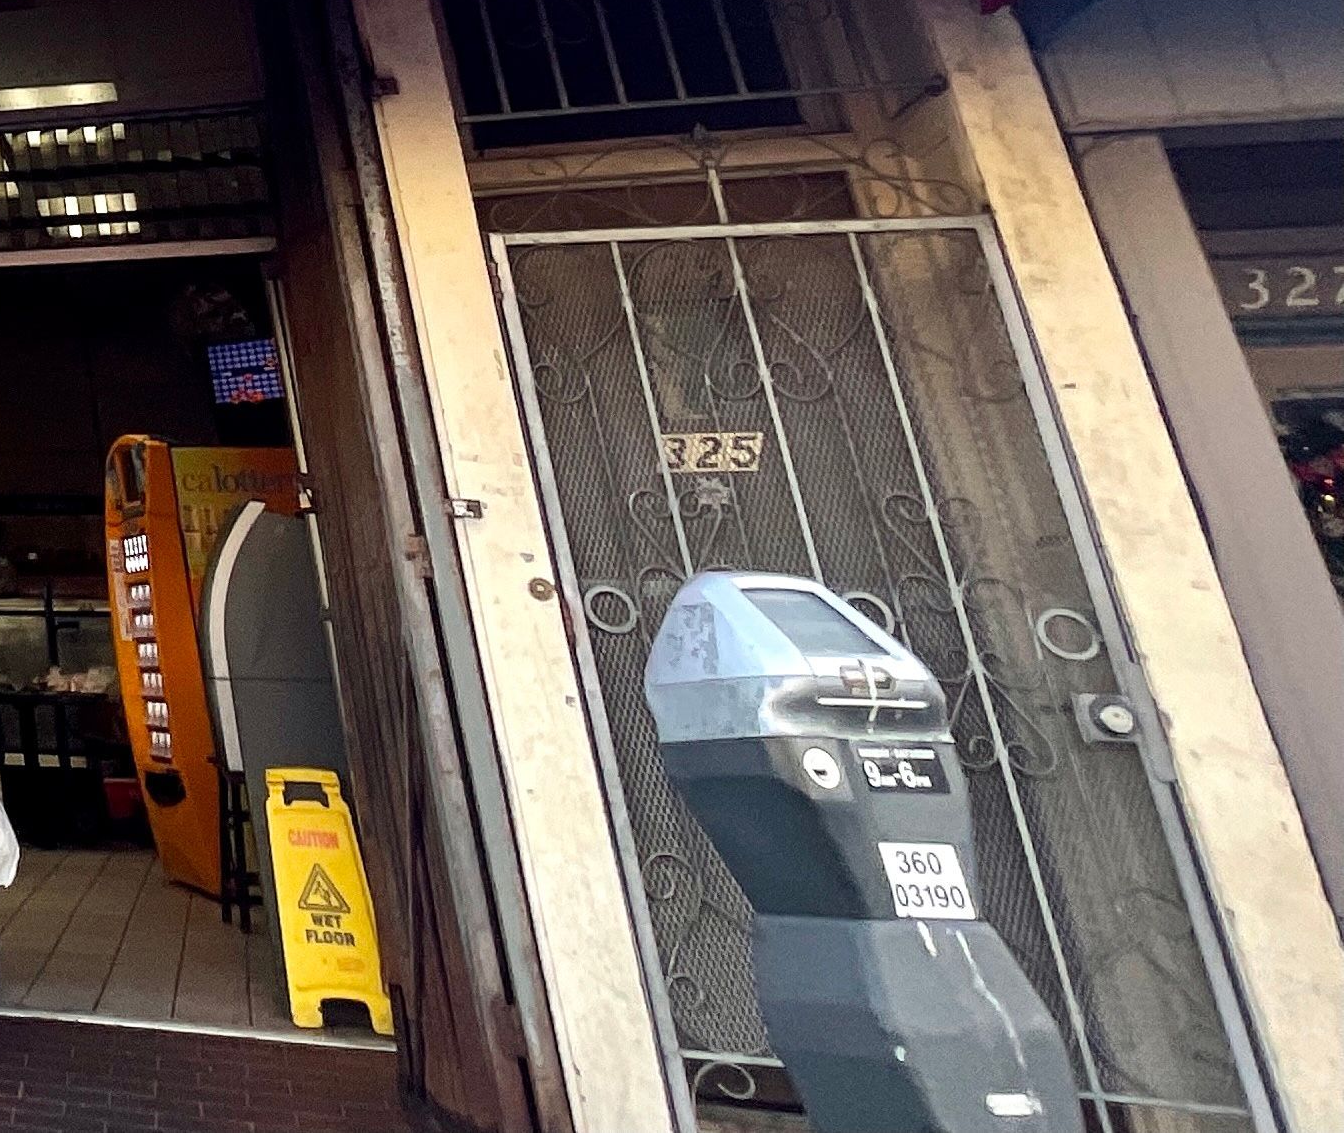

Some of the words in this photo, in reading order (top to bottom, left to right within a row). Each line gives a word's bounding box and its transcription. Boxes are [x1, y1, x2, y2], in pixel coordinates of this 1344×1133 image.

[664, 435, 758, 469] 325
[287, 829, 340, 850] CAUTION
[895, 851, 942, 875] 360
[895, 884, 966, 909] 03190
[310, 912, 343, 929] WET
[305, 928, 356, 947] FLOOR
